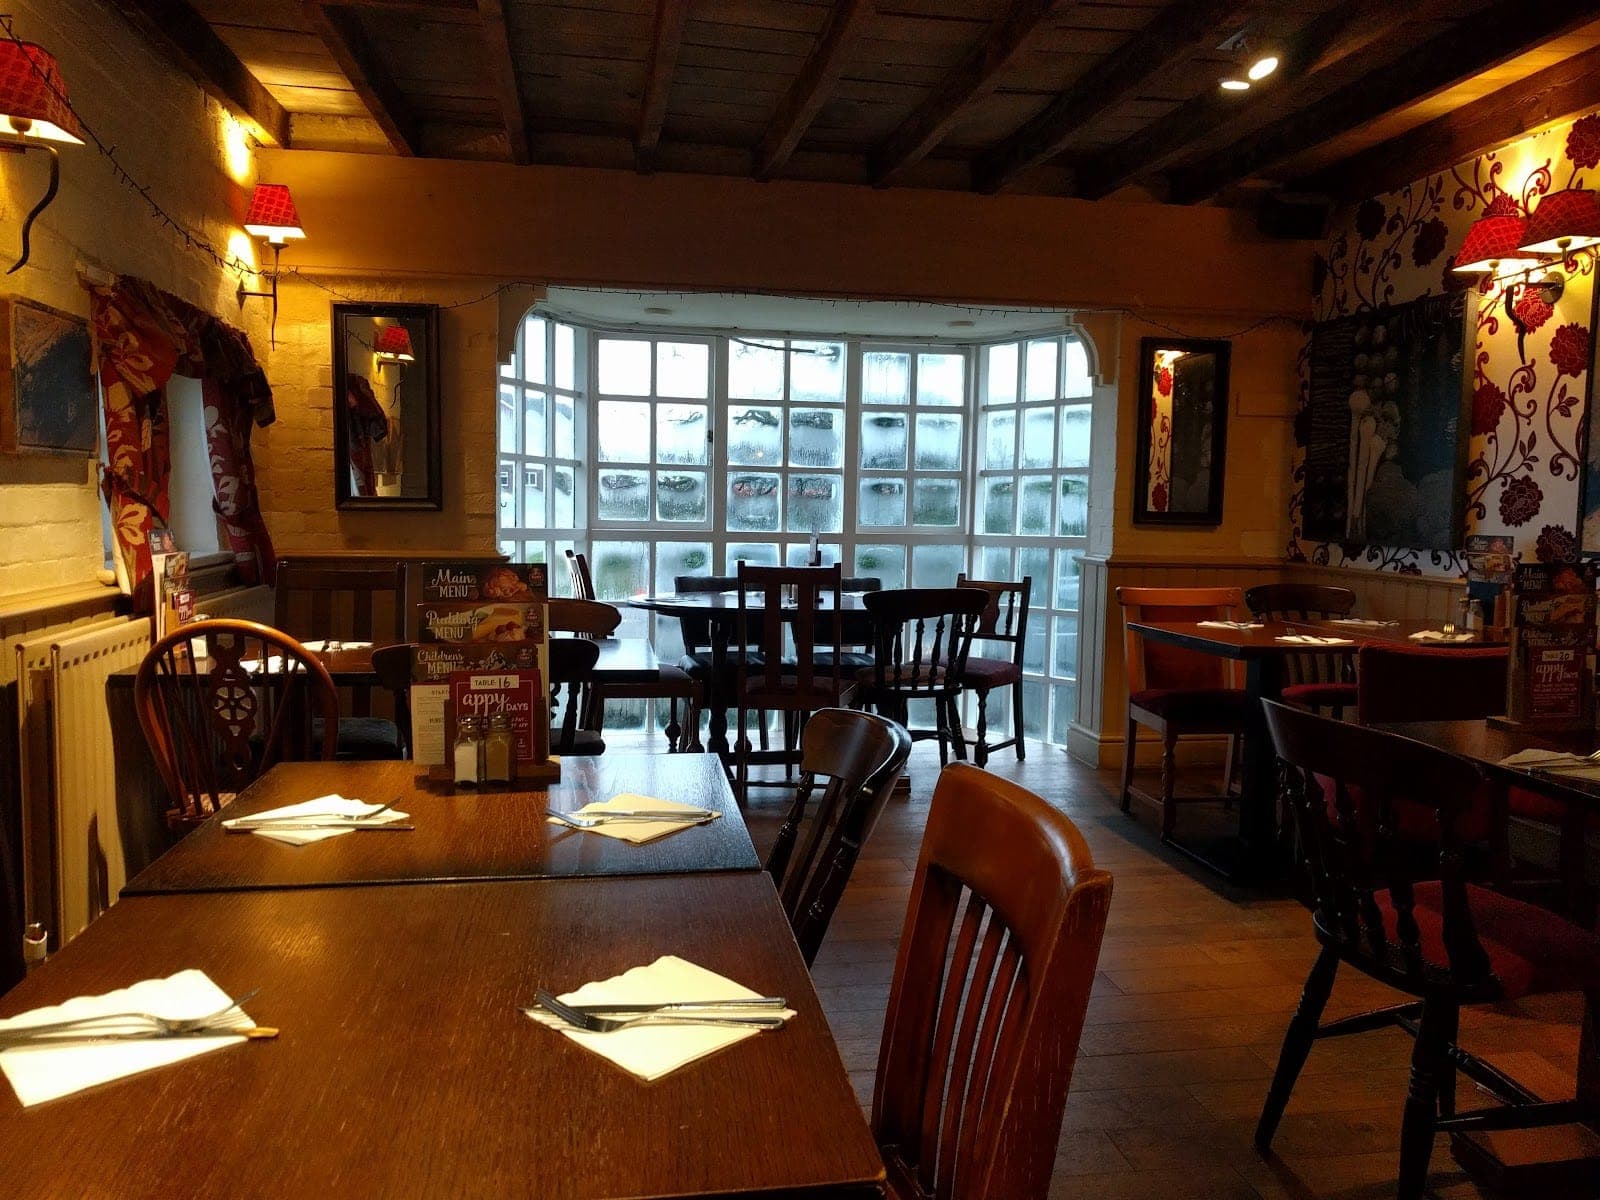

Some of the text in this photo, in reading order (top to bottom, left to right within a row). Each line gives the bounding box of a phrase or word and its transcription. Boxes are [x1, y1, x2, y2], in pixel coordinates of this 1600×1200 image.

[432, 568, 472, 585] Main
[439, 586, 468, 598] MENU
[426, 610, 479, 632] Pudding
[435, 627, 464, 639] MENU
[427, 662, 457, 674] MENU
[1536, 663, 1566, 683] appy
[498, 677, 511, 688] 16
[462, 692, 509, 716] appy
[506, 703, 529, 711] DAYS
